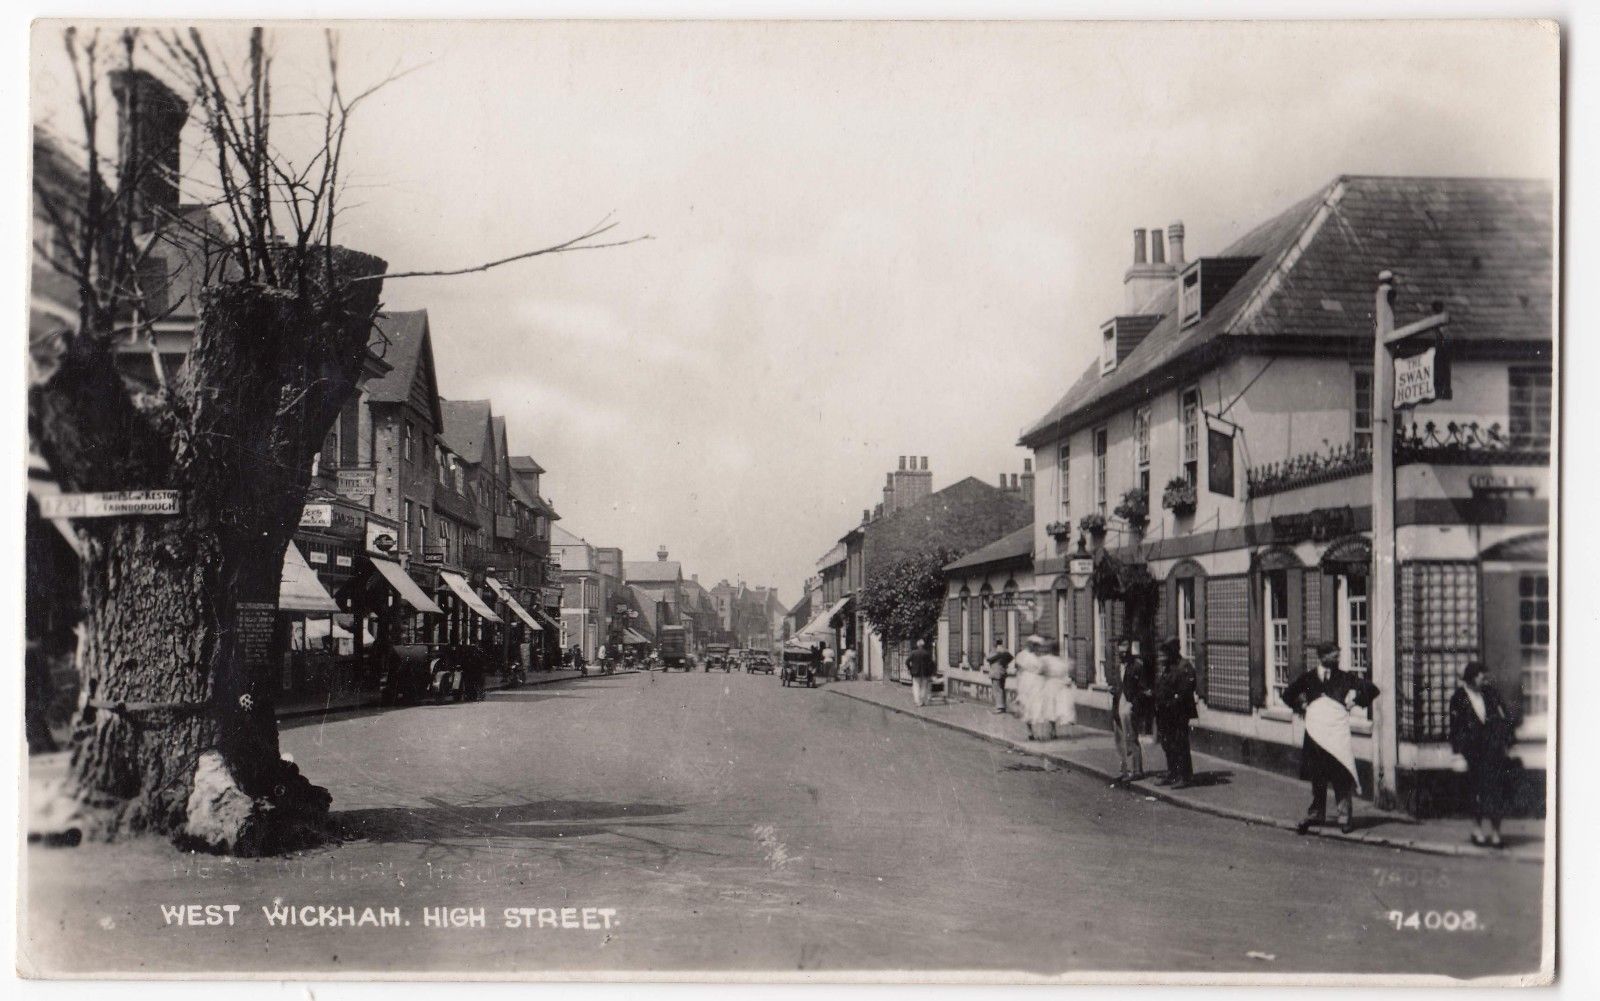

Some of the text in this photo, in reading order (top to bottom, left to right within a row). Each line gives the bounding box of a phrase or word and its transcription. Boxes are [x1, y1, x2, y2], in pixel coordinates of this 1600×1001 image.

[1408, 356, 1422, 371] THE
[1399, 366, 1431, 387] SWAN
[1397, 380, 1433, 401] HOTEL
[145, 491, 178, 500] KESTON
[103, 502, 176, 513] FARNBOROUGH
